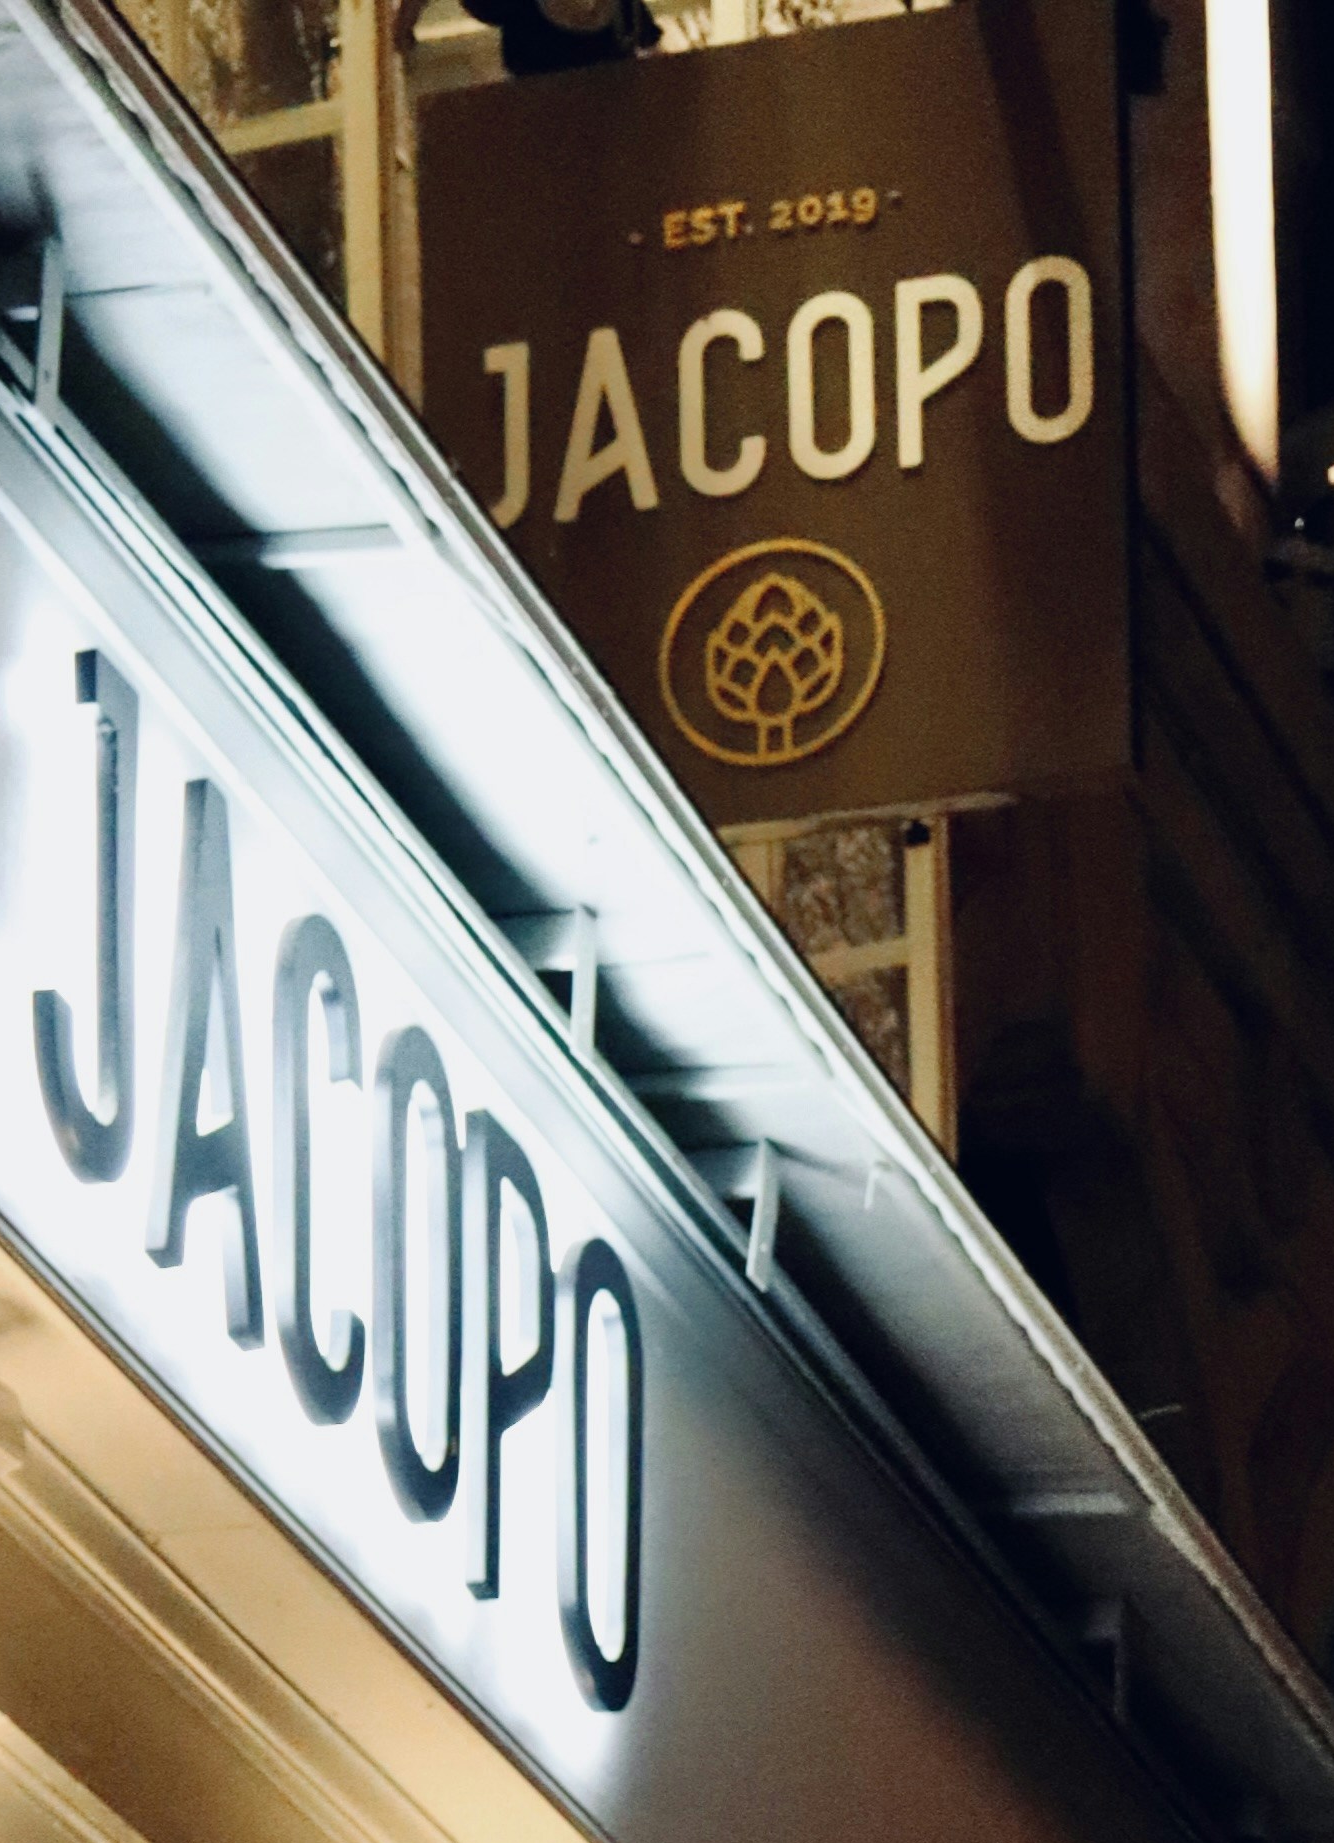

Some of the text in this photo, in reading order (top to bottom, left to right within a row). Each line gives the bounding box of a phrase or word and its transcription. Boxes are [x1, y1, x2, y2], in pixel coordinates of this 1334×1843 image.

[769, 187, 878, 234] 2019
[483, 254, 1095, 530] JACOPO
[32, 648, 645, 1713] JACOPO
